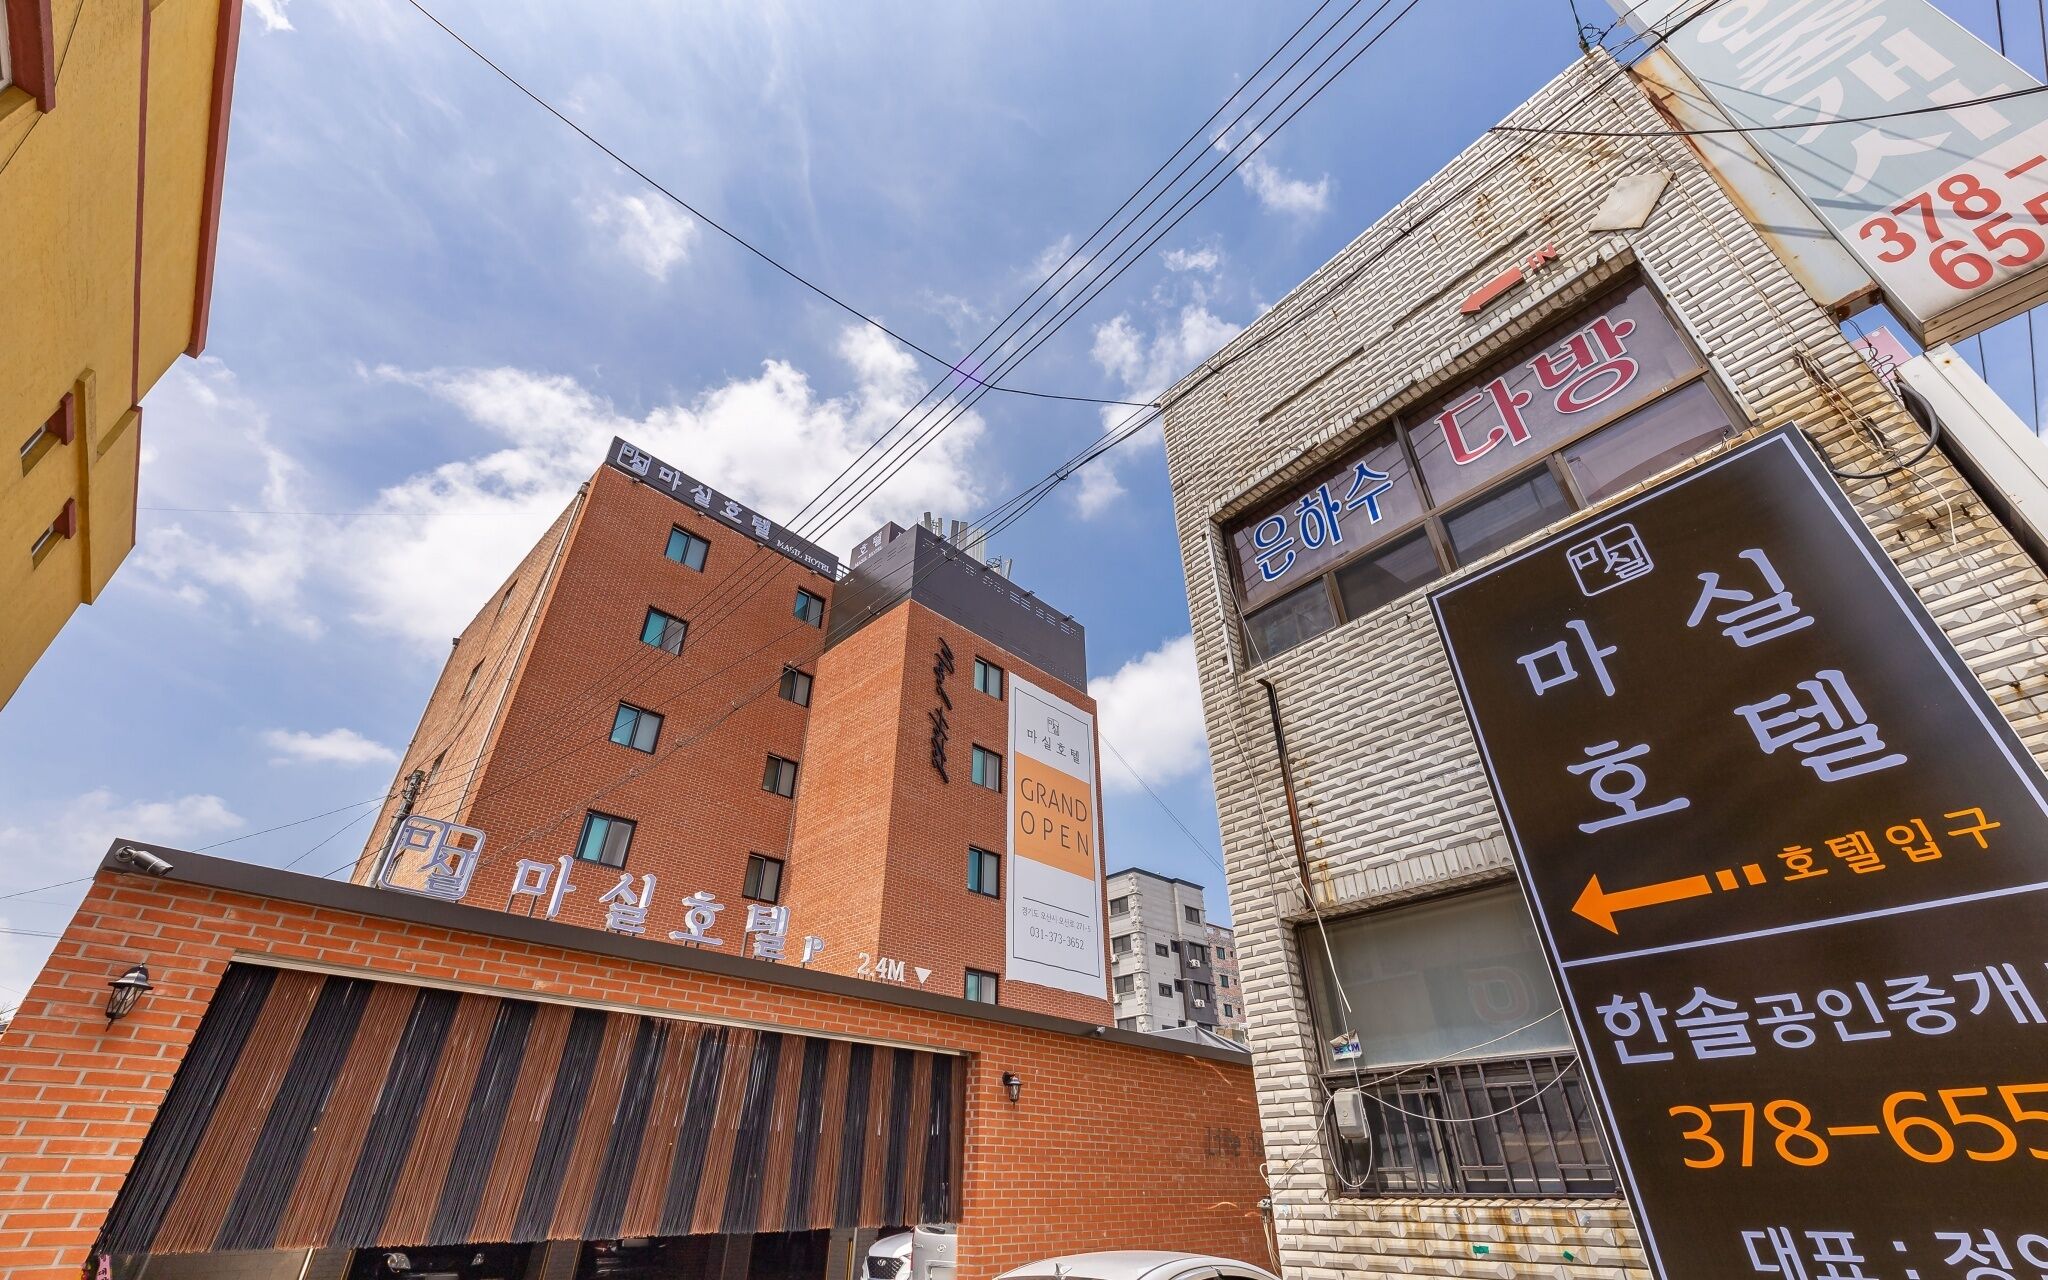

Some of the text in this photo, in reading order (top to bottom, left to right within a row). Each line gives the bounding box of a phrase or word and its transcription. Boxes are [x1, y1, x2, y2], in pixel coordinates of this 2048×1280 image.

[1527, 242, 1557, 271] IN
[1434, 315, 1640, 466] 다방
[1254, 460, 1394, 583] 은하수
[776, 539, 832, 574] MASIL HOTEL
[1021, 778, 1087, 822] GRAND
[1021, 810, 1089, 857] OPEN
[1030, 926, 1085, 950] 031-373-3652
[1596, 962, 2048, 1065] 한솔공인중개
